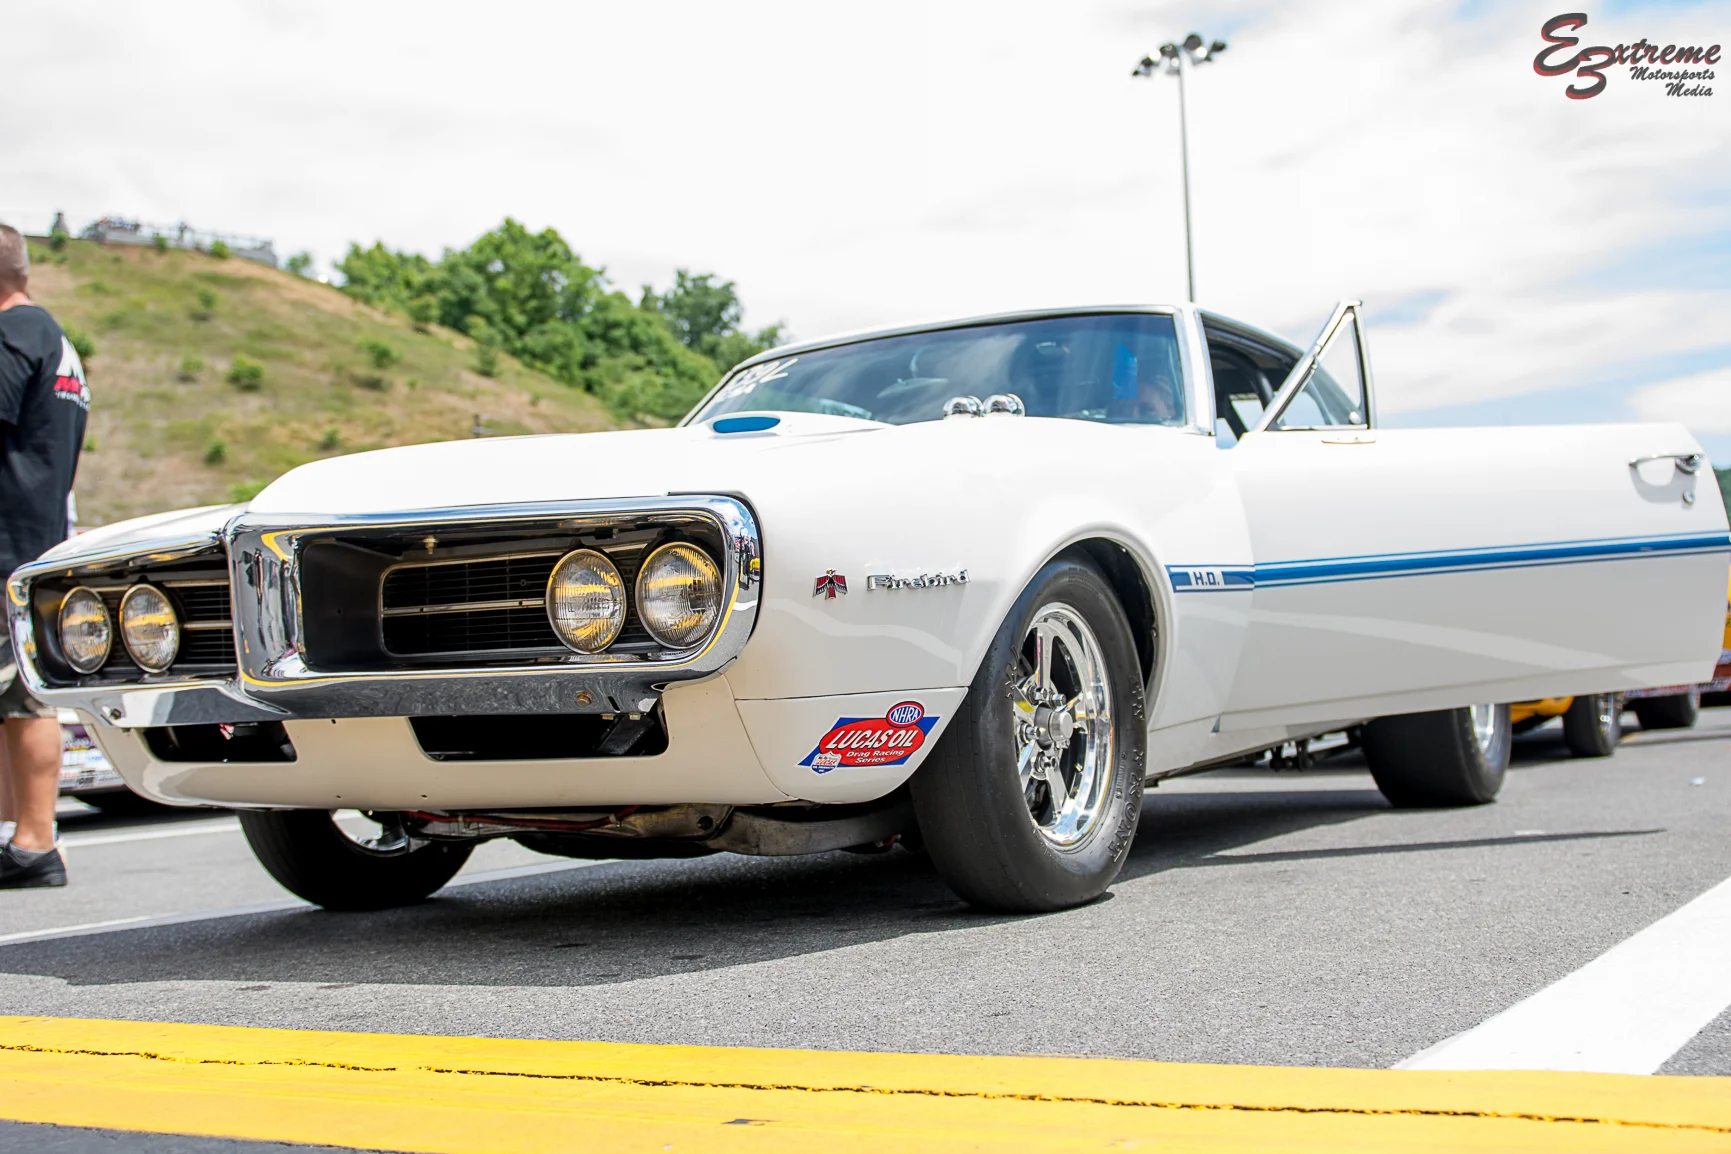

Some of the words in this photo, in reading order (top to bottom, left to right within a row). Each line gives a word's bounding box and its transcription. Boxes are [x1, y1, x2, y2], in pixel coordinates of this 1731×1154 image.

[866, 569, 972, 591] Firebird
[1193, 571, 1220, 586] H.D.
[892, 705, 920, 724] NHRA
[825, 729, 894, 749] LUCAS
[887, 729, 919, 748] OIL
[854, 756, 886, 764] Series
[873, 749, 905, 757] Racing
